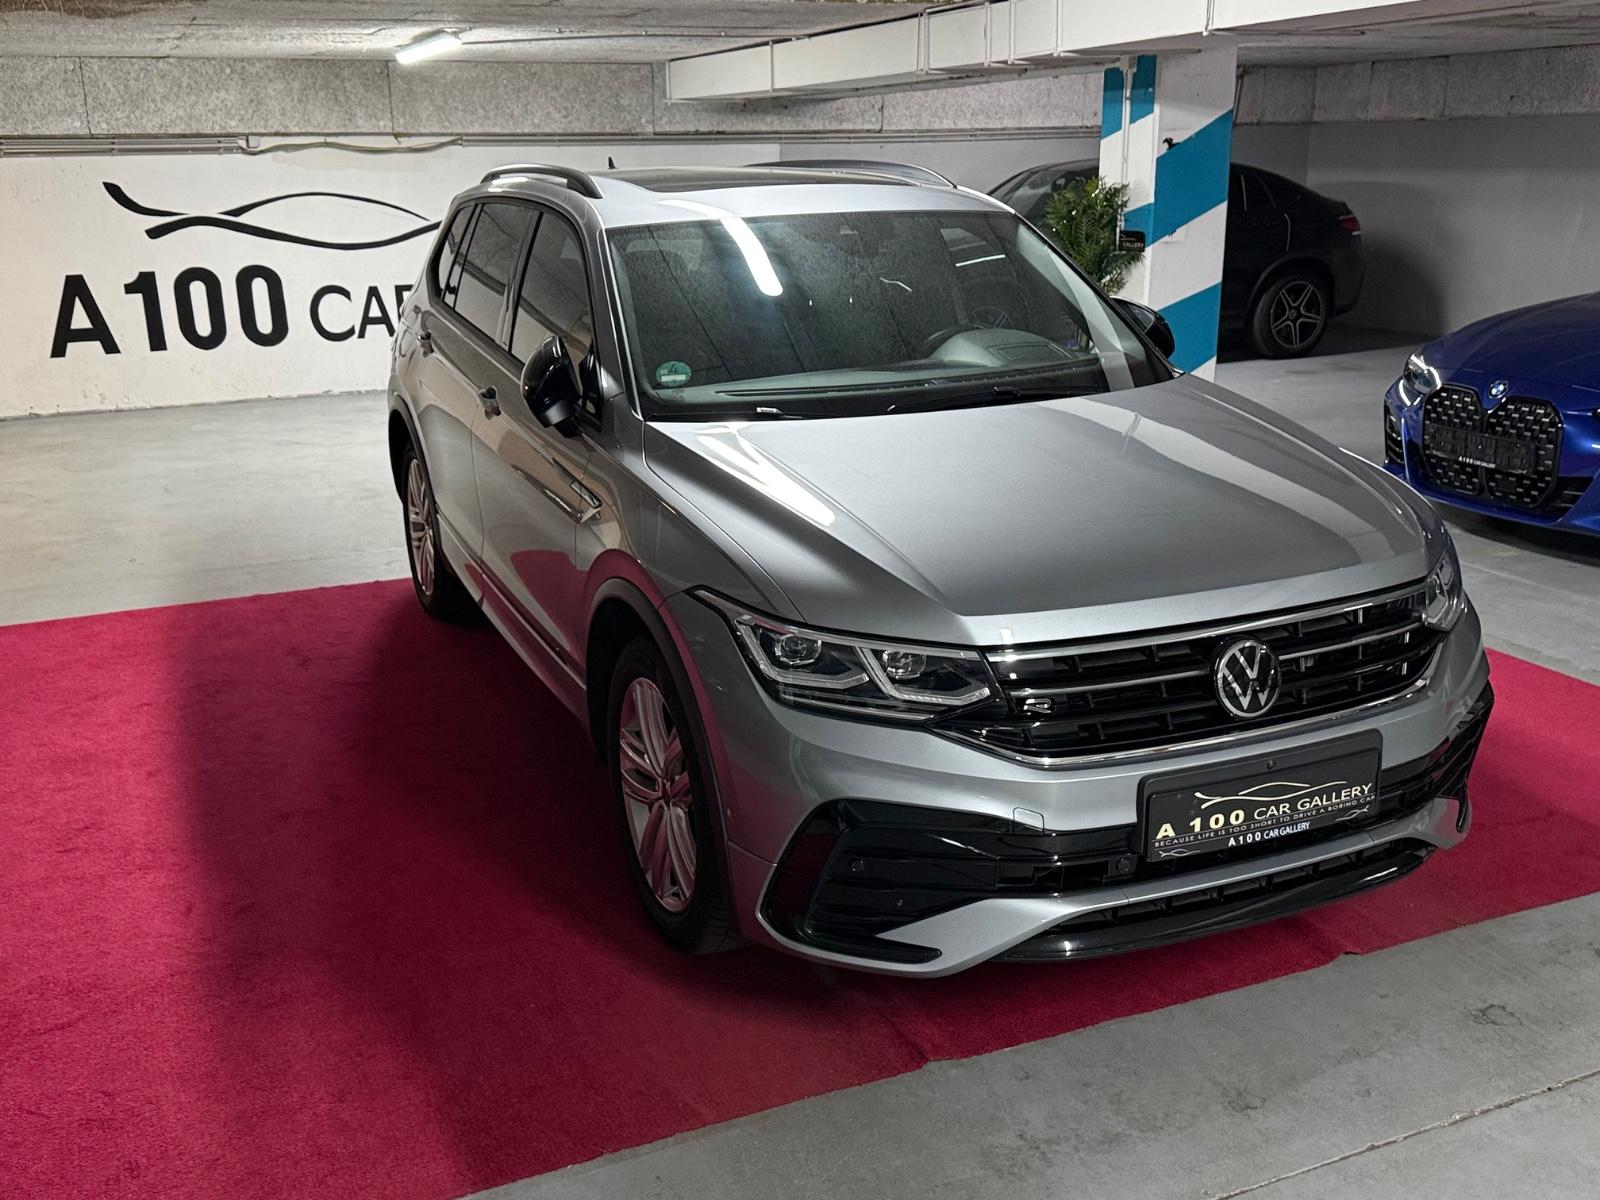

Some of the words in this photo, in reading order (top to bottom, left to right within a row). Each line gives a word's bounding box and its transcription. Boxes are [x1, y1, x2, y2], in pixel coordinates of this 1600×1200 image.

[1154, 835, 1195, 848] BECAUSE
[1198, 832, 1215, 840] LIFE
[1229, 825, 1247, 833] TOO
[1250, 819, 1276, 829] SHORT
[1293, 810, 1317, 819] DRIVE
[1328, 800, 1357, 811] BORING
[1360, 795, 1375, 803] CAR
[1253, 803, 1291, 820] CAR
[1297, 782, 1372, 811] GALLERY
